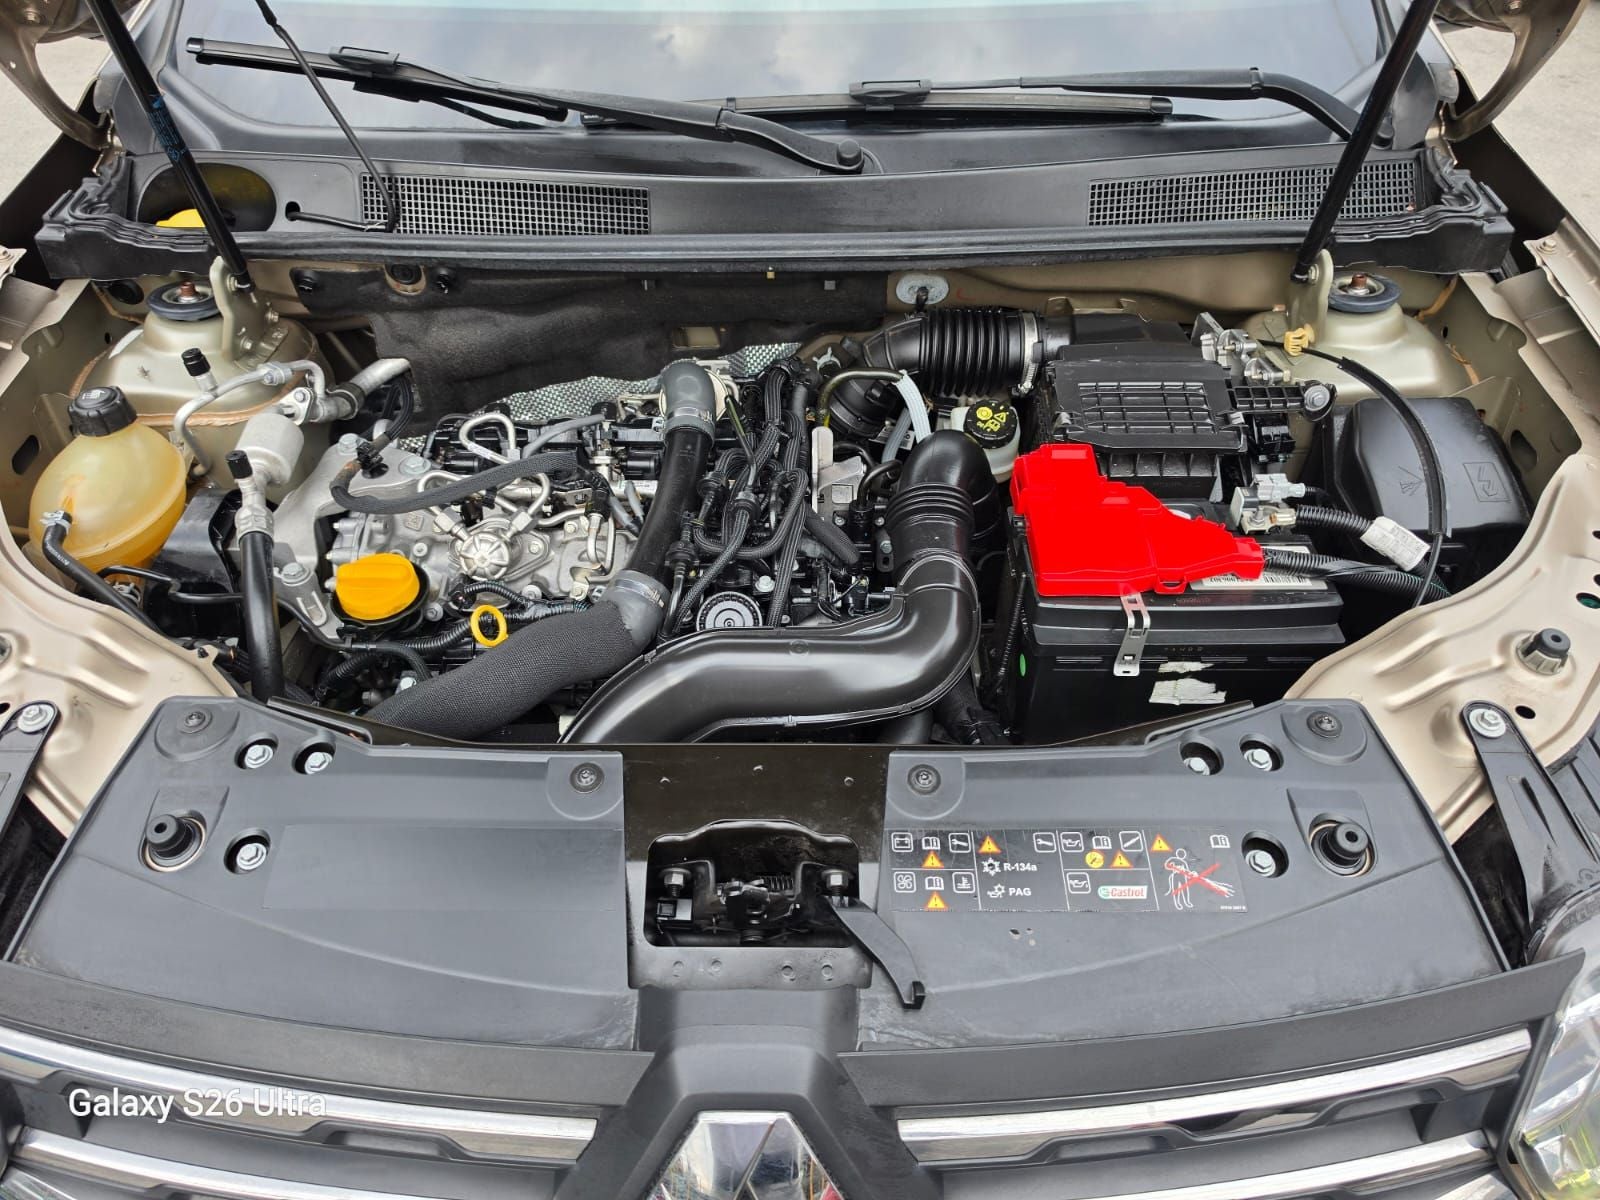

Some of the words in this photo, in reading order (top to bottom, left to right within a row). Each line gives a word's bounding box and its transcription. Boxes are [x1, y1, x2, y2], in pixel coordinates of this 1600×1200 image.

[1003, 862, 1038, 872] R-134a
[1008, 887, 1032, 897] PAG
[1110, 887, 1145, 898] Castrol
